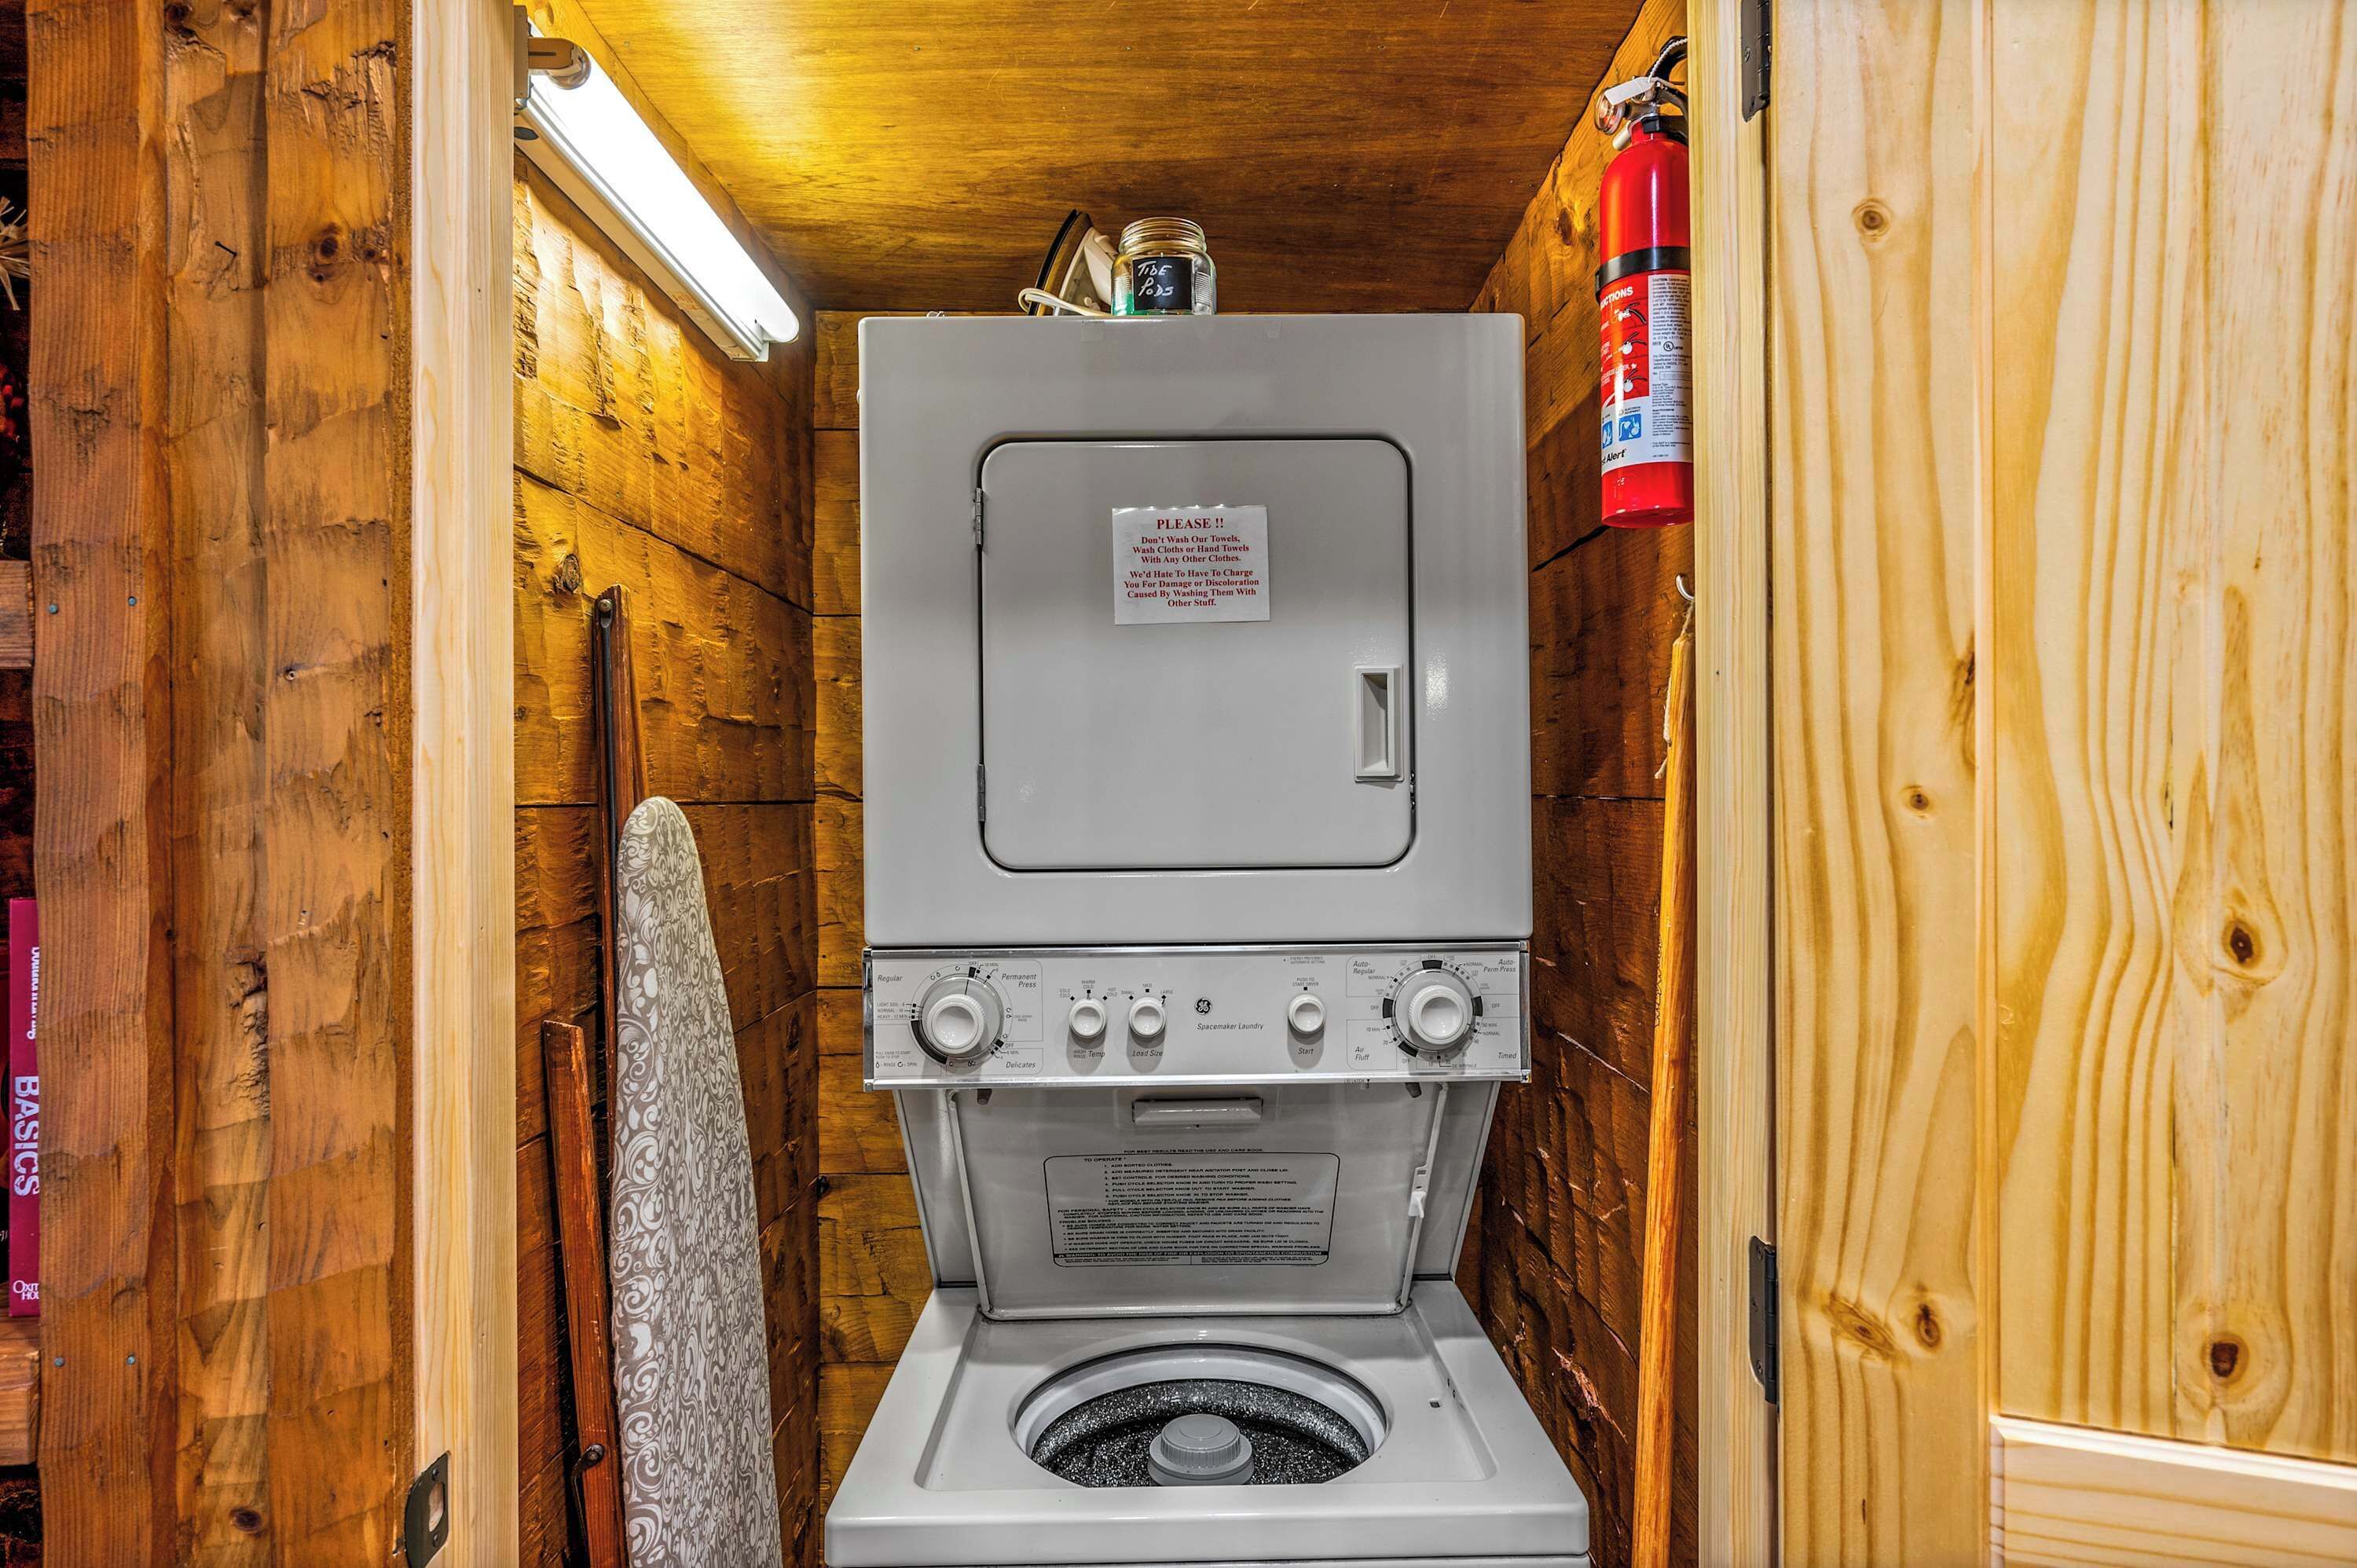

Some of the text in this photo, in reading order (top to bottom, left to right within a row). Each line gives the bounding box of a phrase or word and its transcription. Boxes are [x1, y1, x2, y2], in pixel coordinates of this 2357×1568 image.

[1138, 261, 1172, 277] TIDE
[1607, 449, 1625, 463] Alert
[1157, 518, 1223, 529] PLEASE !!
[1163, 556, 1179, 564] Any
[1223, 569, 1253, 578] Charge
[1160, 590, 1170, 599] By
[1173, 589, 1208, 597] Washing
[877, 975, 902, 983] Regular
[14, 1075, 39, 1196] BASICS
